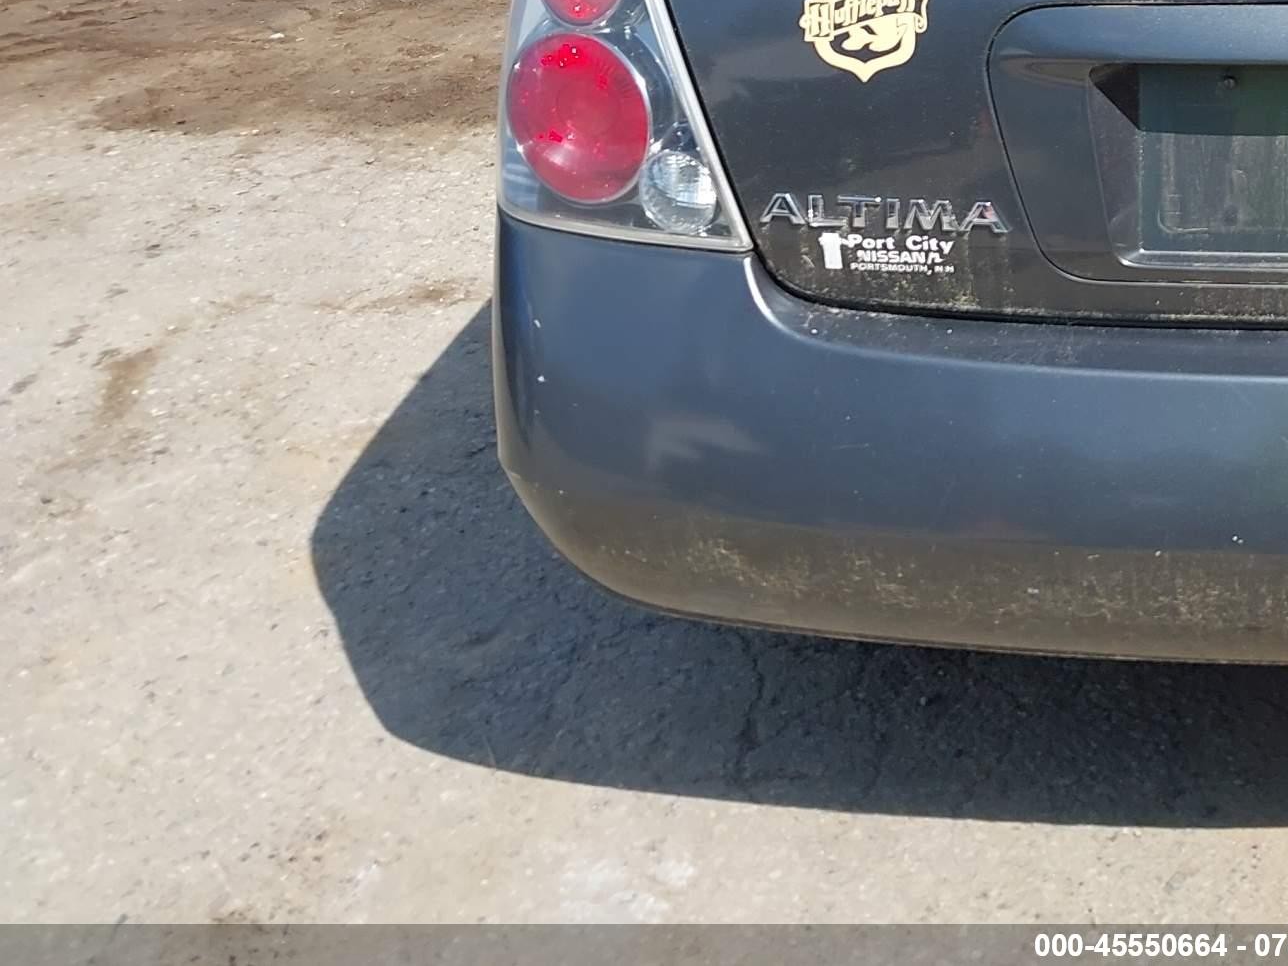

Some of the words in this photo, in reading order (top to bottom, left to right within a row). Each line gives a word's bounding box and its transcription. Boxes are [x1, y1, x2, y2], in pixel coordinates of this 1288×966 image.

[759, 191, 1010, 235] ALTIMA
[847, 233, 896, 250] Port
[905, 234, 956, 255] City
